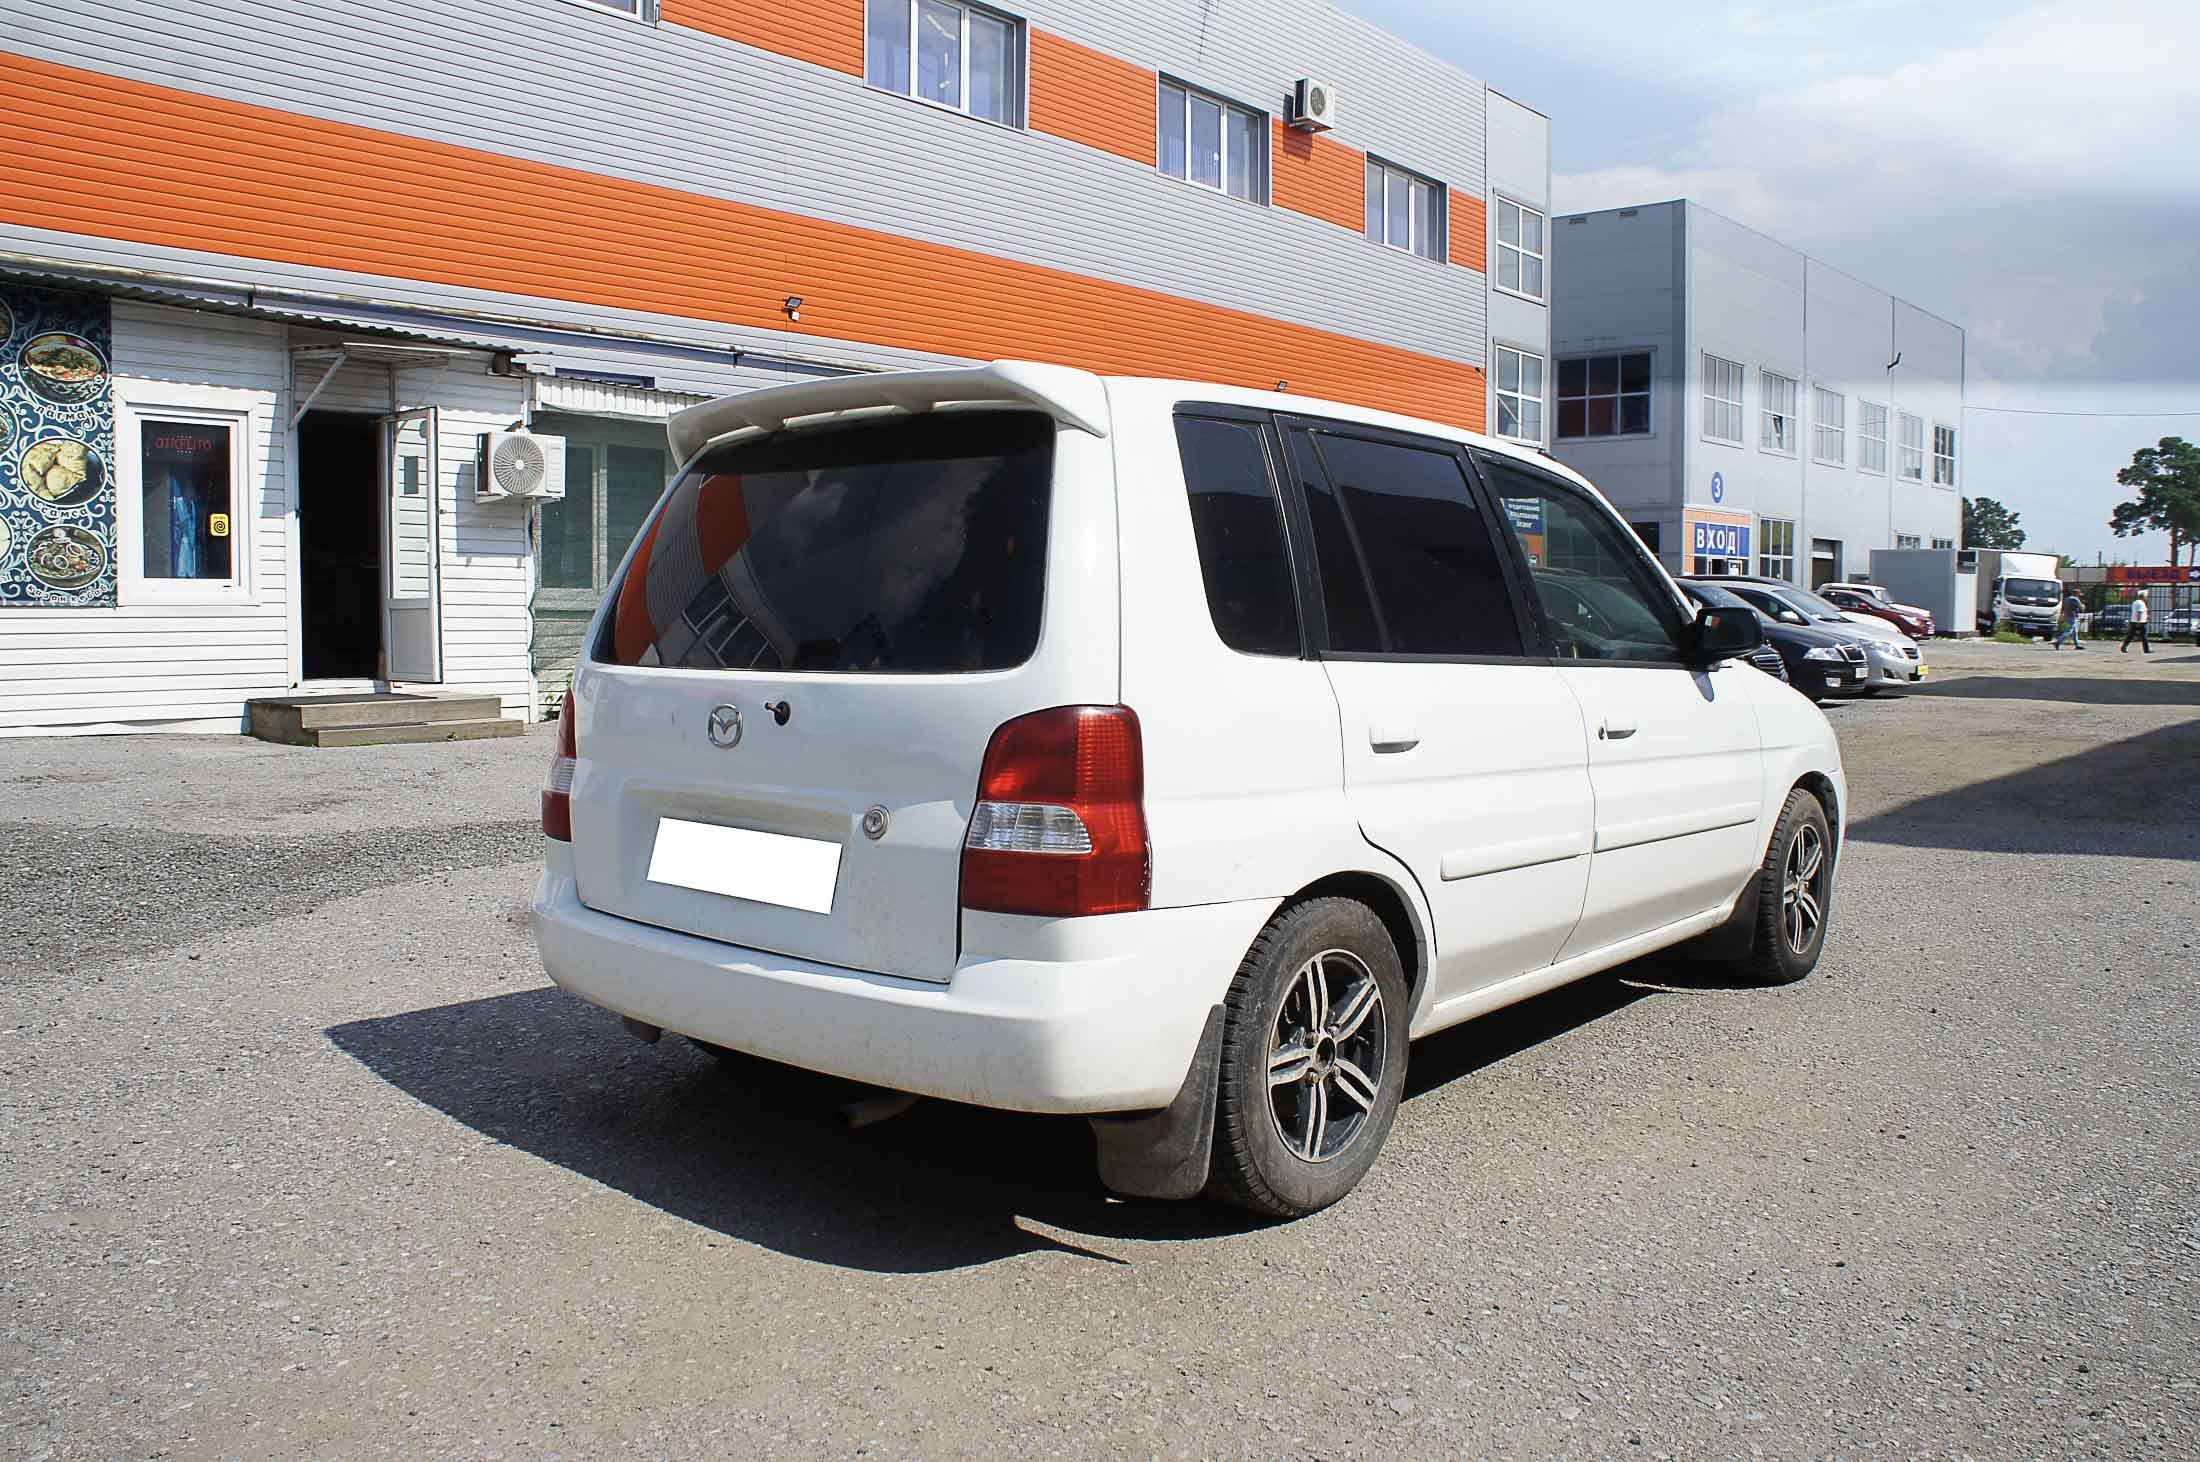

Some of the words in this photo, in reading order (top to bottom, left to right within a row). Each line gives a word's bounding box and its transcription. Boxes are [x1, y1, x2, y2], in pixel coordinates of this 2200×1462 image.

[35, 406, 96, 421] лагман
[1714, 478, 1721, 498] 3
[41, 506, 88, 518] самса
[1696, 528, 1736, 554] ВХОД
[27, 584, 67, 602] казан
[71, 584, 108, 602] кебаб
